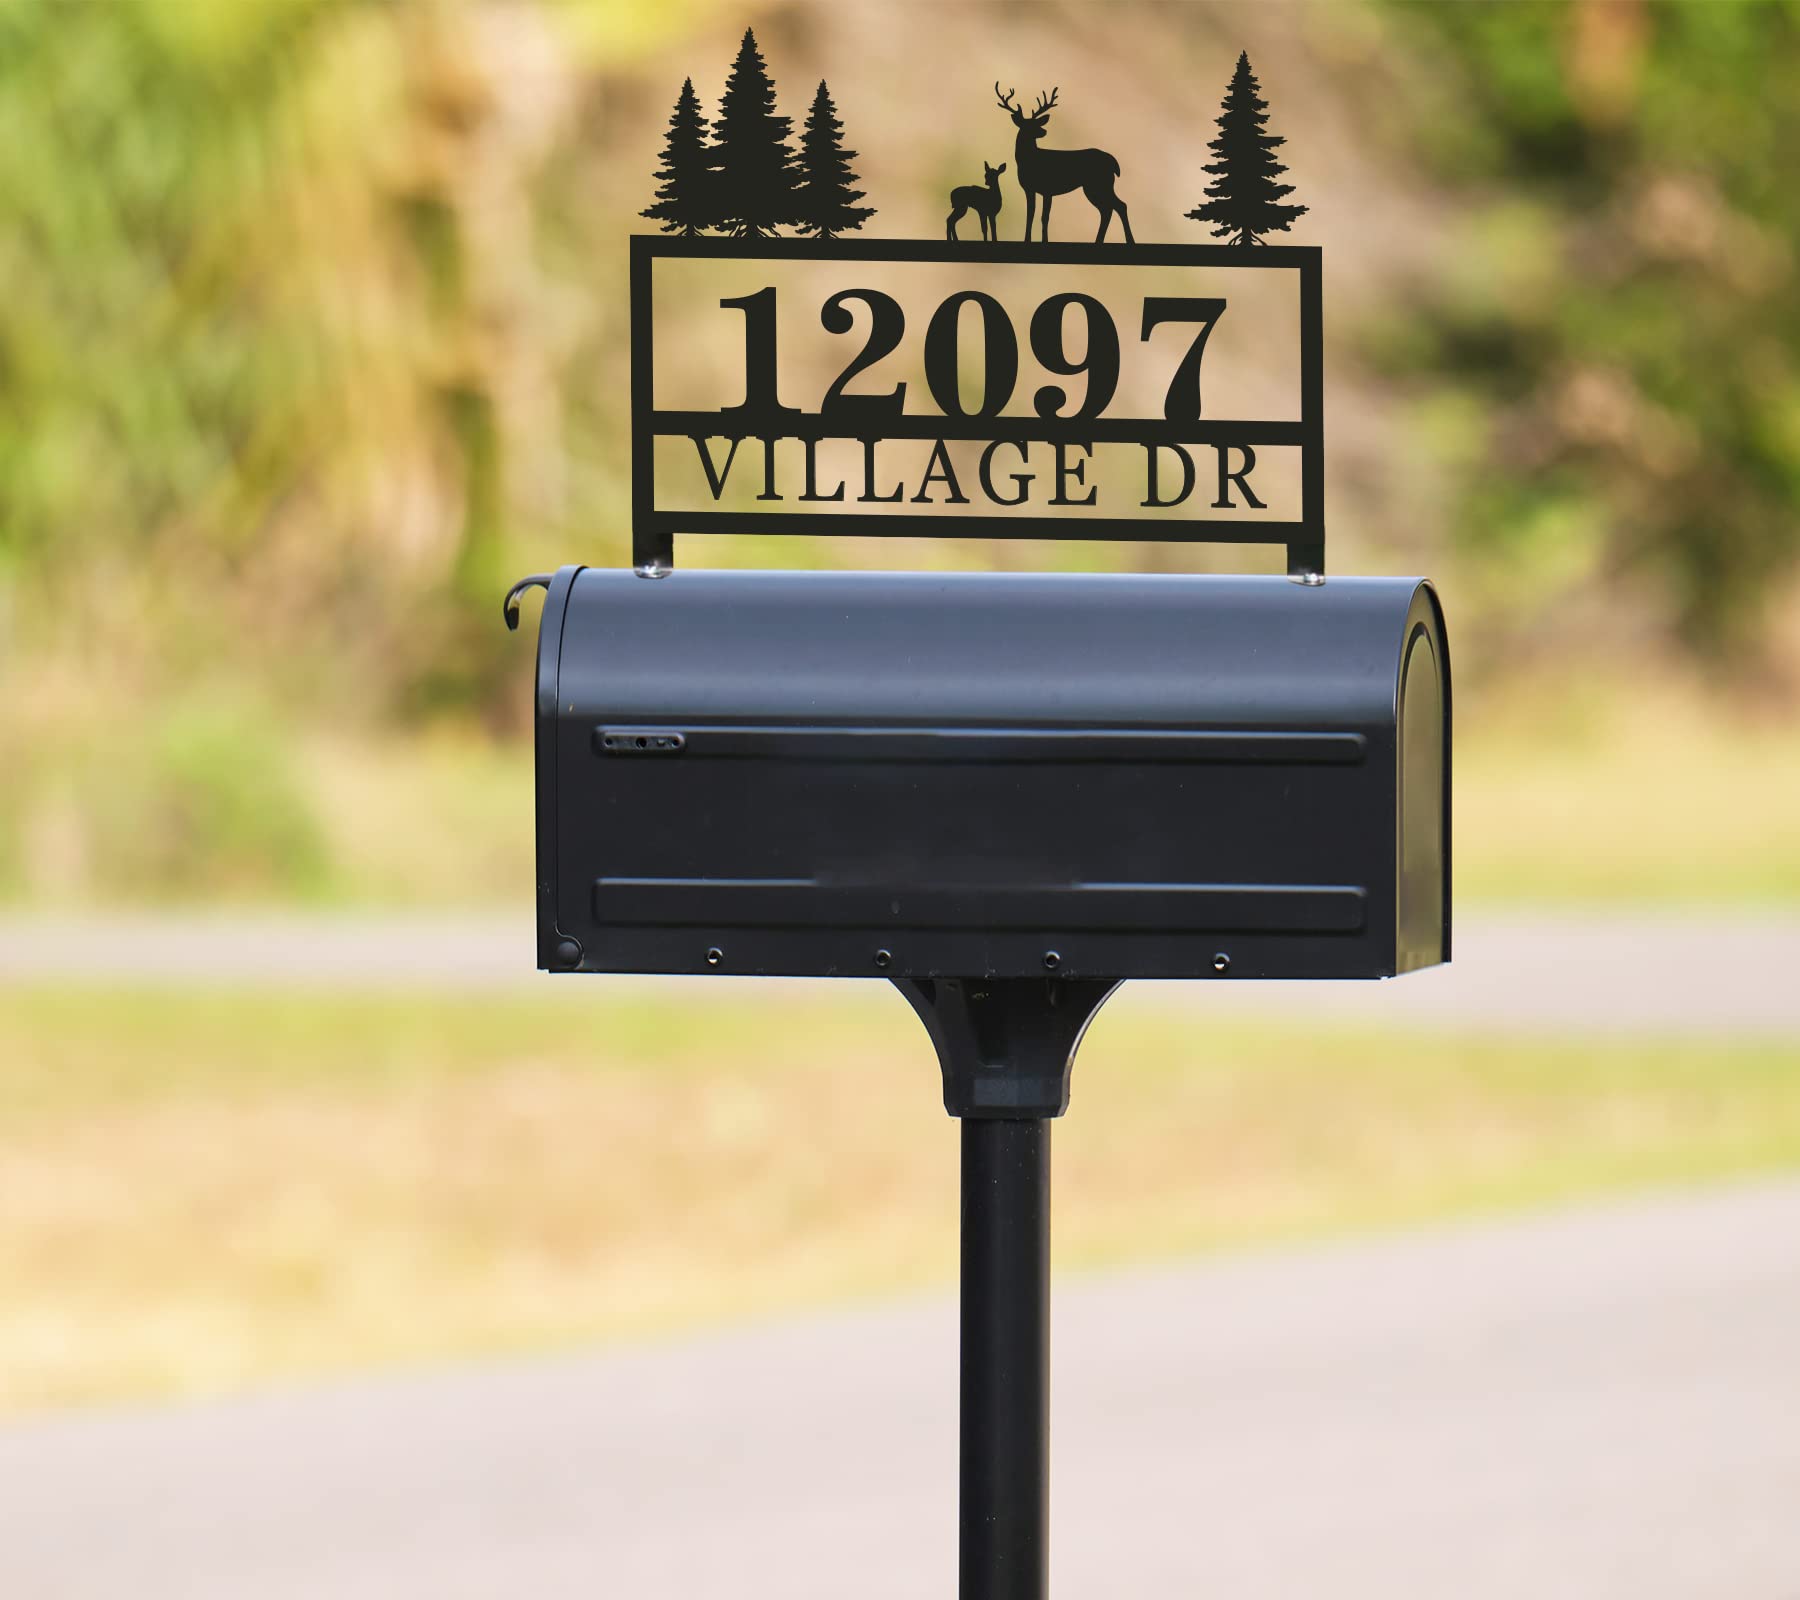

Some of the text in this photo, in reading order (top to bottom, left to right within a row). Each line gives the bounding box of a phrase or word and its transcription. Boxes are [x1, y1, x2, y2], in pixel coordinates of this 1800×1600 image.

[719, 286, 1228, 421] 12097
[687, 434, 1268, 509] VILLAGE DR
